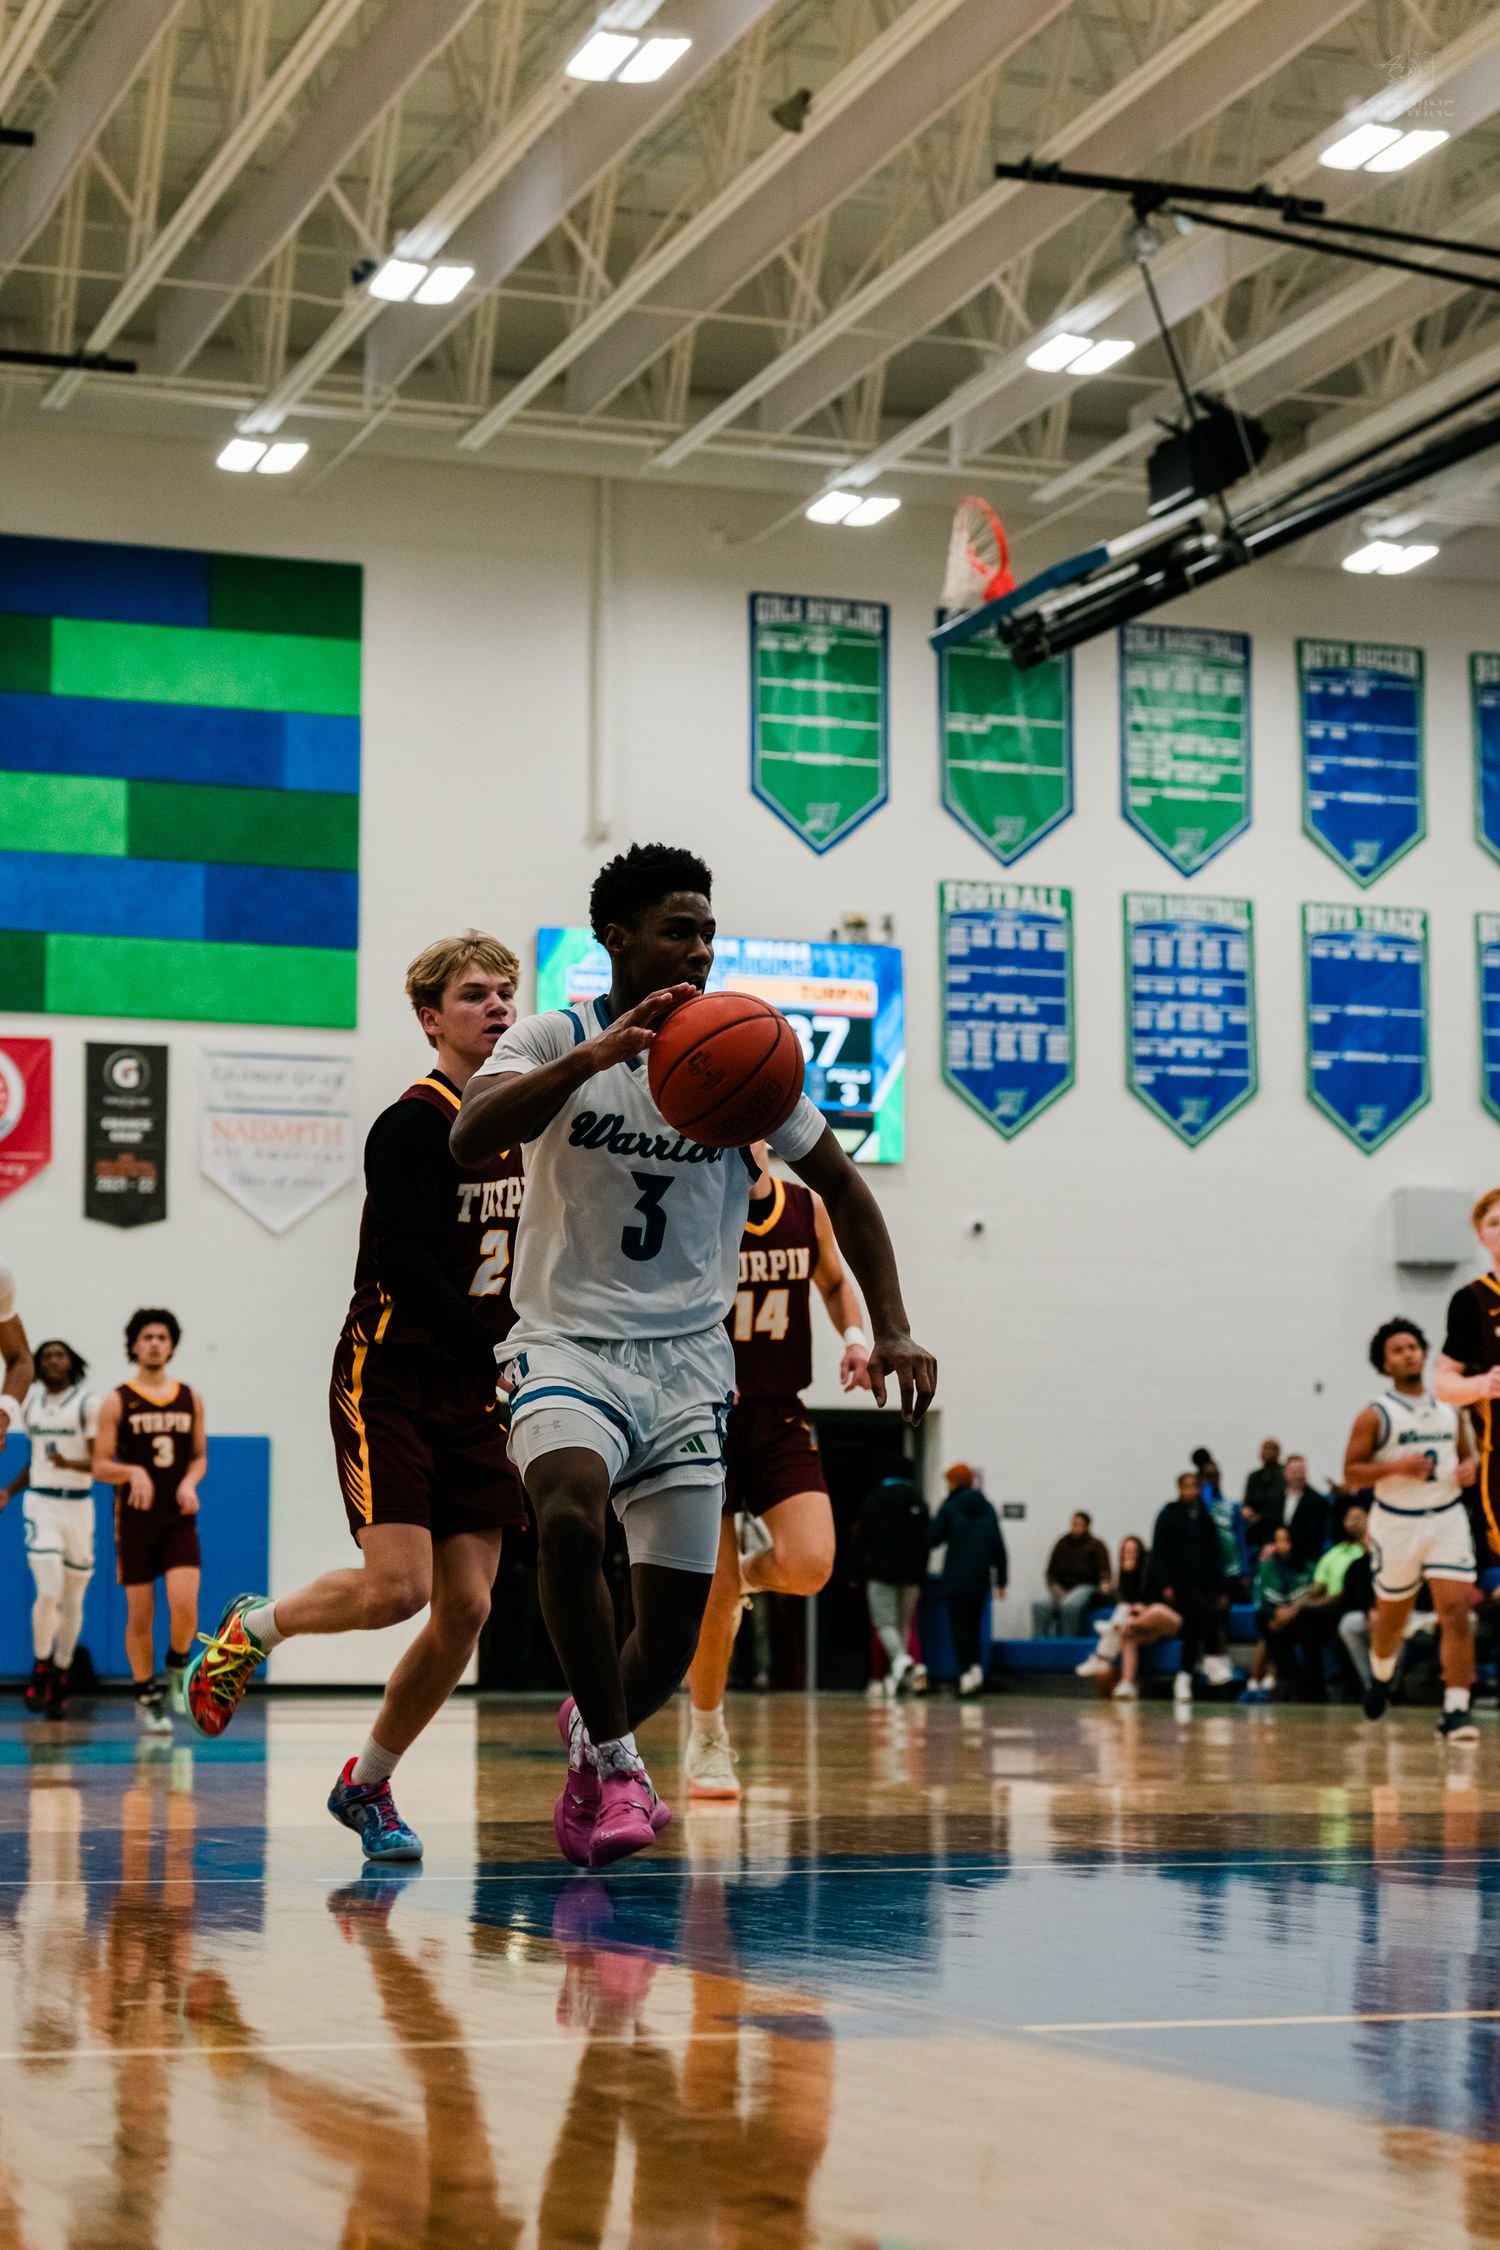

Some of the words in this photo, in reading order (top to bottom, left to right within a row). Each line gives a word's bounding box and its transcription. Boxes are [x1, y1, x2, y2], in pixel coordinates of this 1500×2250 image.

[945, 883, 1067, 918] FOOTBALL
[801, 983, 872, 1003] TURPIN
[840, 1082, 860, 1107] 3
[211, 1119, 343, 1147] NAISMITH
[621, 1171, 675, 1261] 3
[468, 1229, 510, 1297] 2
[738, 1246, 810, 1283] URPIN
[733, 1288, 789, 1342] 14
[129, 1411, 192, 1434] TURPIN
[152, 1435, 174, 1468] 3
